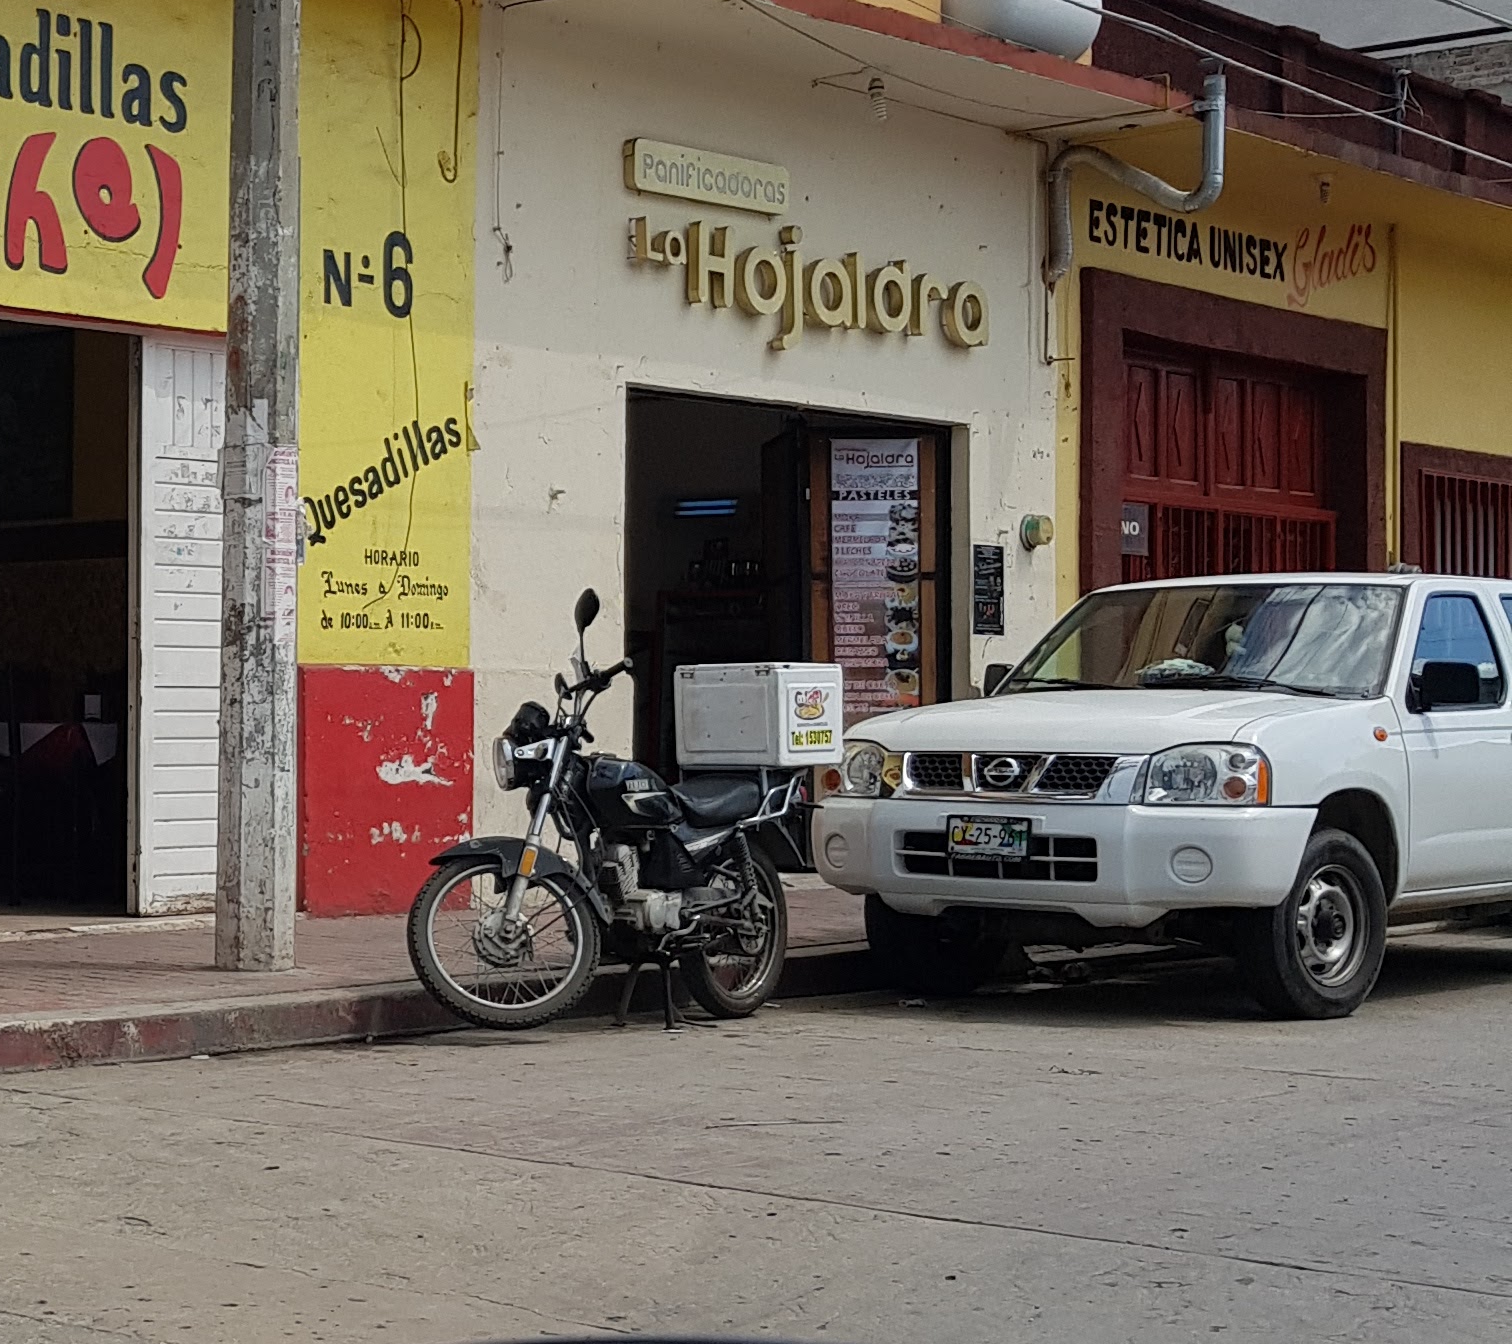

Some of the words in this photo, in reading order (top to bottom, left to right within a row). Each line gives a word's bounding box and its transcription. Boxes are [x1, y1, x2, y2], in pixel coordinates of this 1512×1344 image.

[642, 153, 786, 205] Panificadoras
[1088, 198, 1202, 266] ESTETICA
[1209, 225, 1287, 282] UNISEX
[630, 216, 687, 265] La
[687, 220, 990, 351] Hojaldra
[846, 451, 914, 469] Hojaldra
[303, 417, 462, 546] Quesadillas
[839, 490, 911, 501] PASTELES
[364, 549, 419, 567] HORARIO
[321, 570, 368, 598] Lunes
[397, 574, 449, 600] Domingo
[320, 609, 333, 630] de
